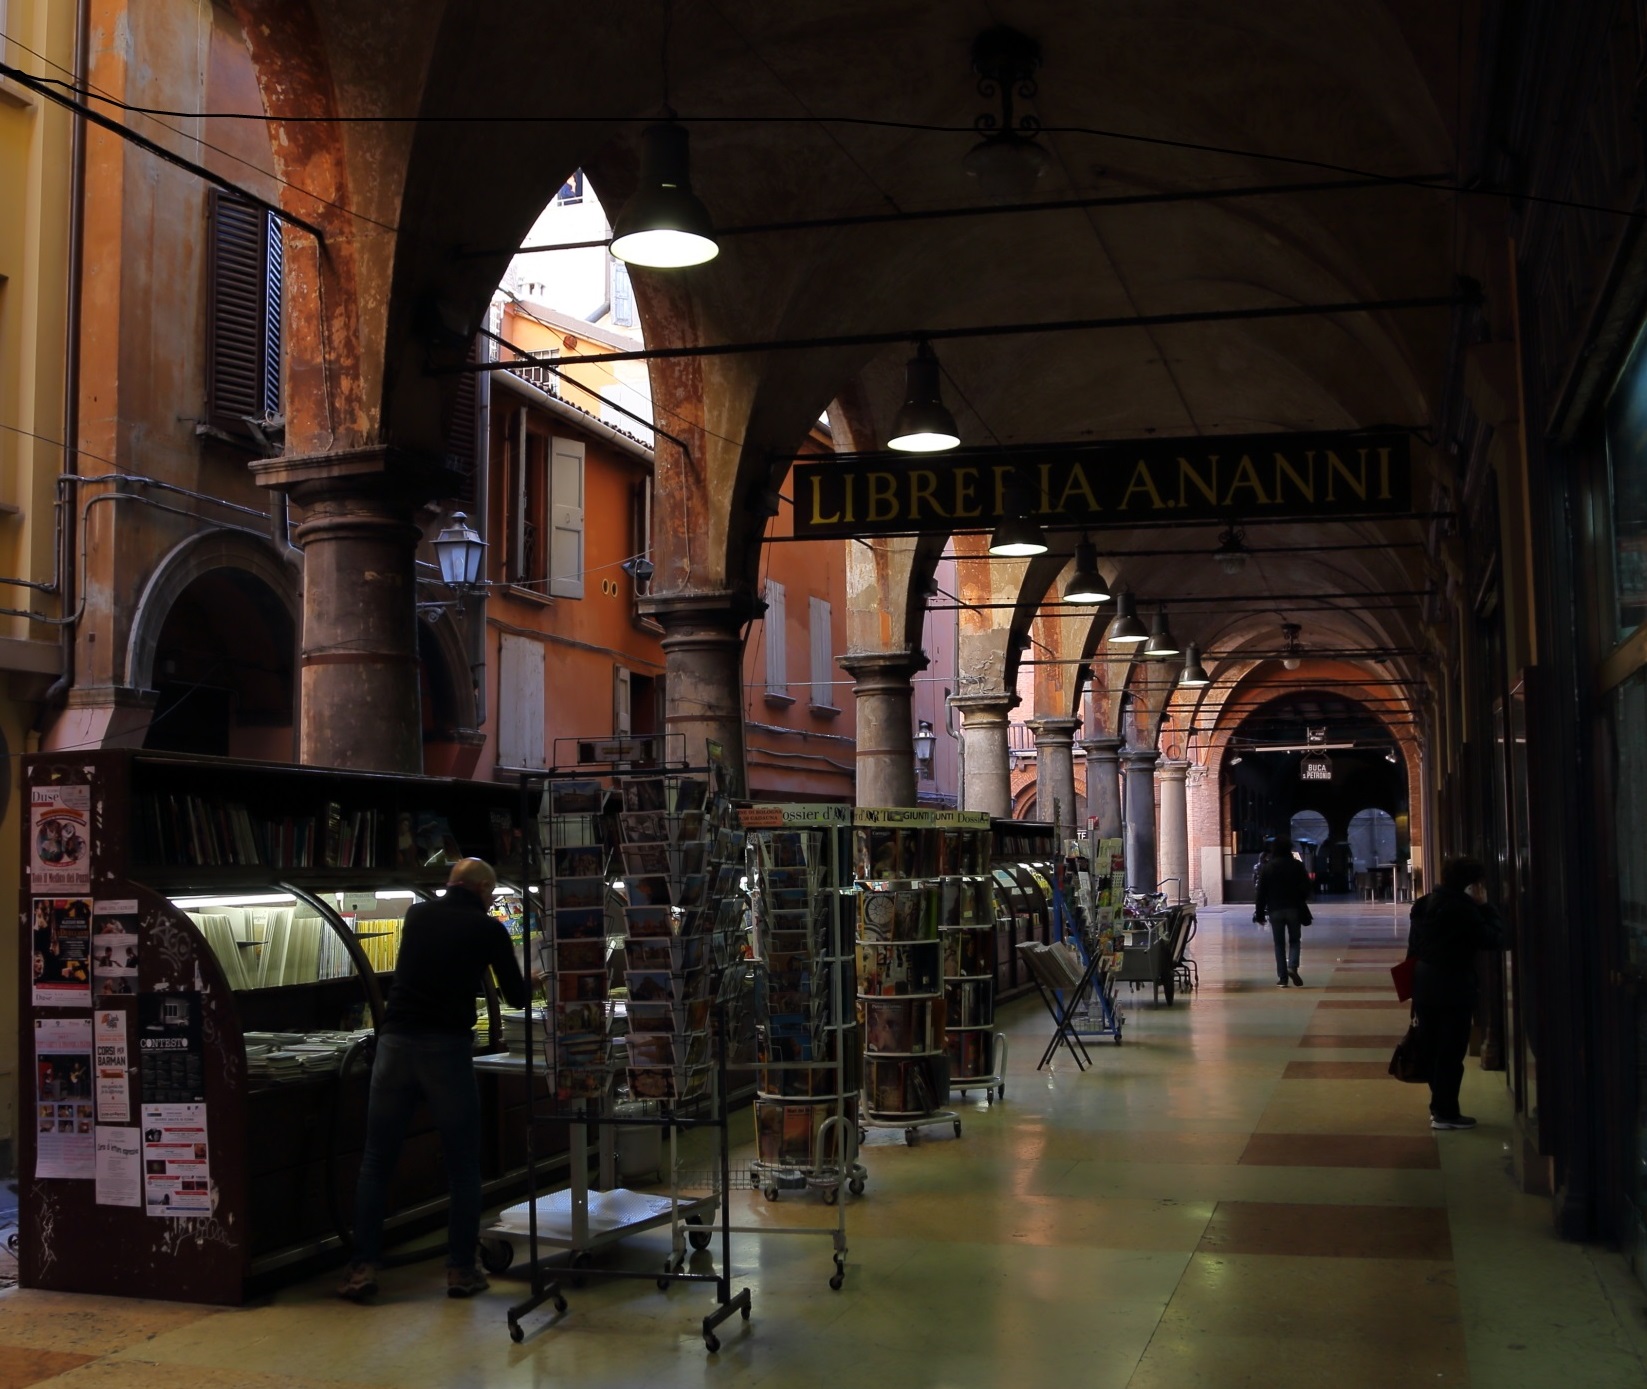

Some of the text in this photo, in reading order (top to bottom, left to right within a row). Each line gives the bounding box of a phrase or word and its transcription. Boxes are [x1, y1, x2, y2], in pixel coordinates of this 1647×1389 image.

[1308, 763, 1327, 771] BUCA
[33, 791, 59, 802] Duse
[782, 806, 820, 820] ossier
[903, 811, 929, 820] GIUNTI
[140, 1037, 189, 1048] CONTESTO
[97, 1046, 116, 1055] CORSI
[97, 1056, 126, 1066] BARMAN
